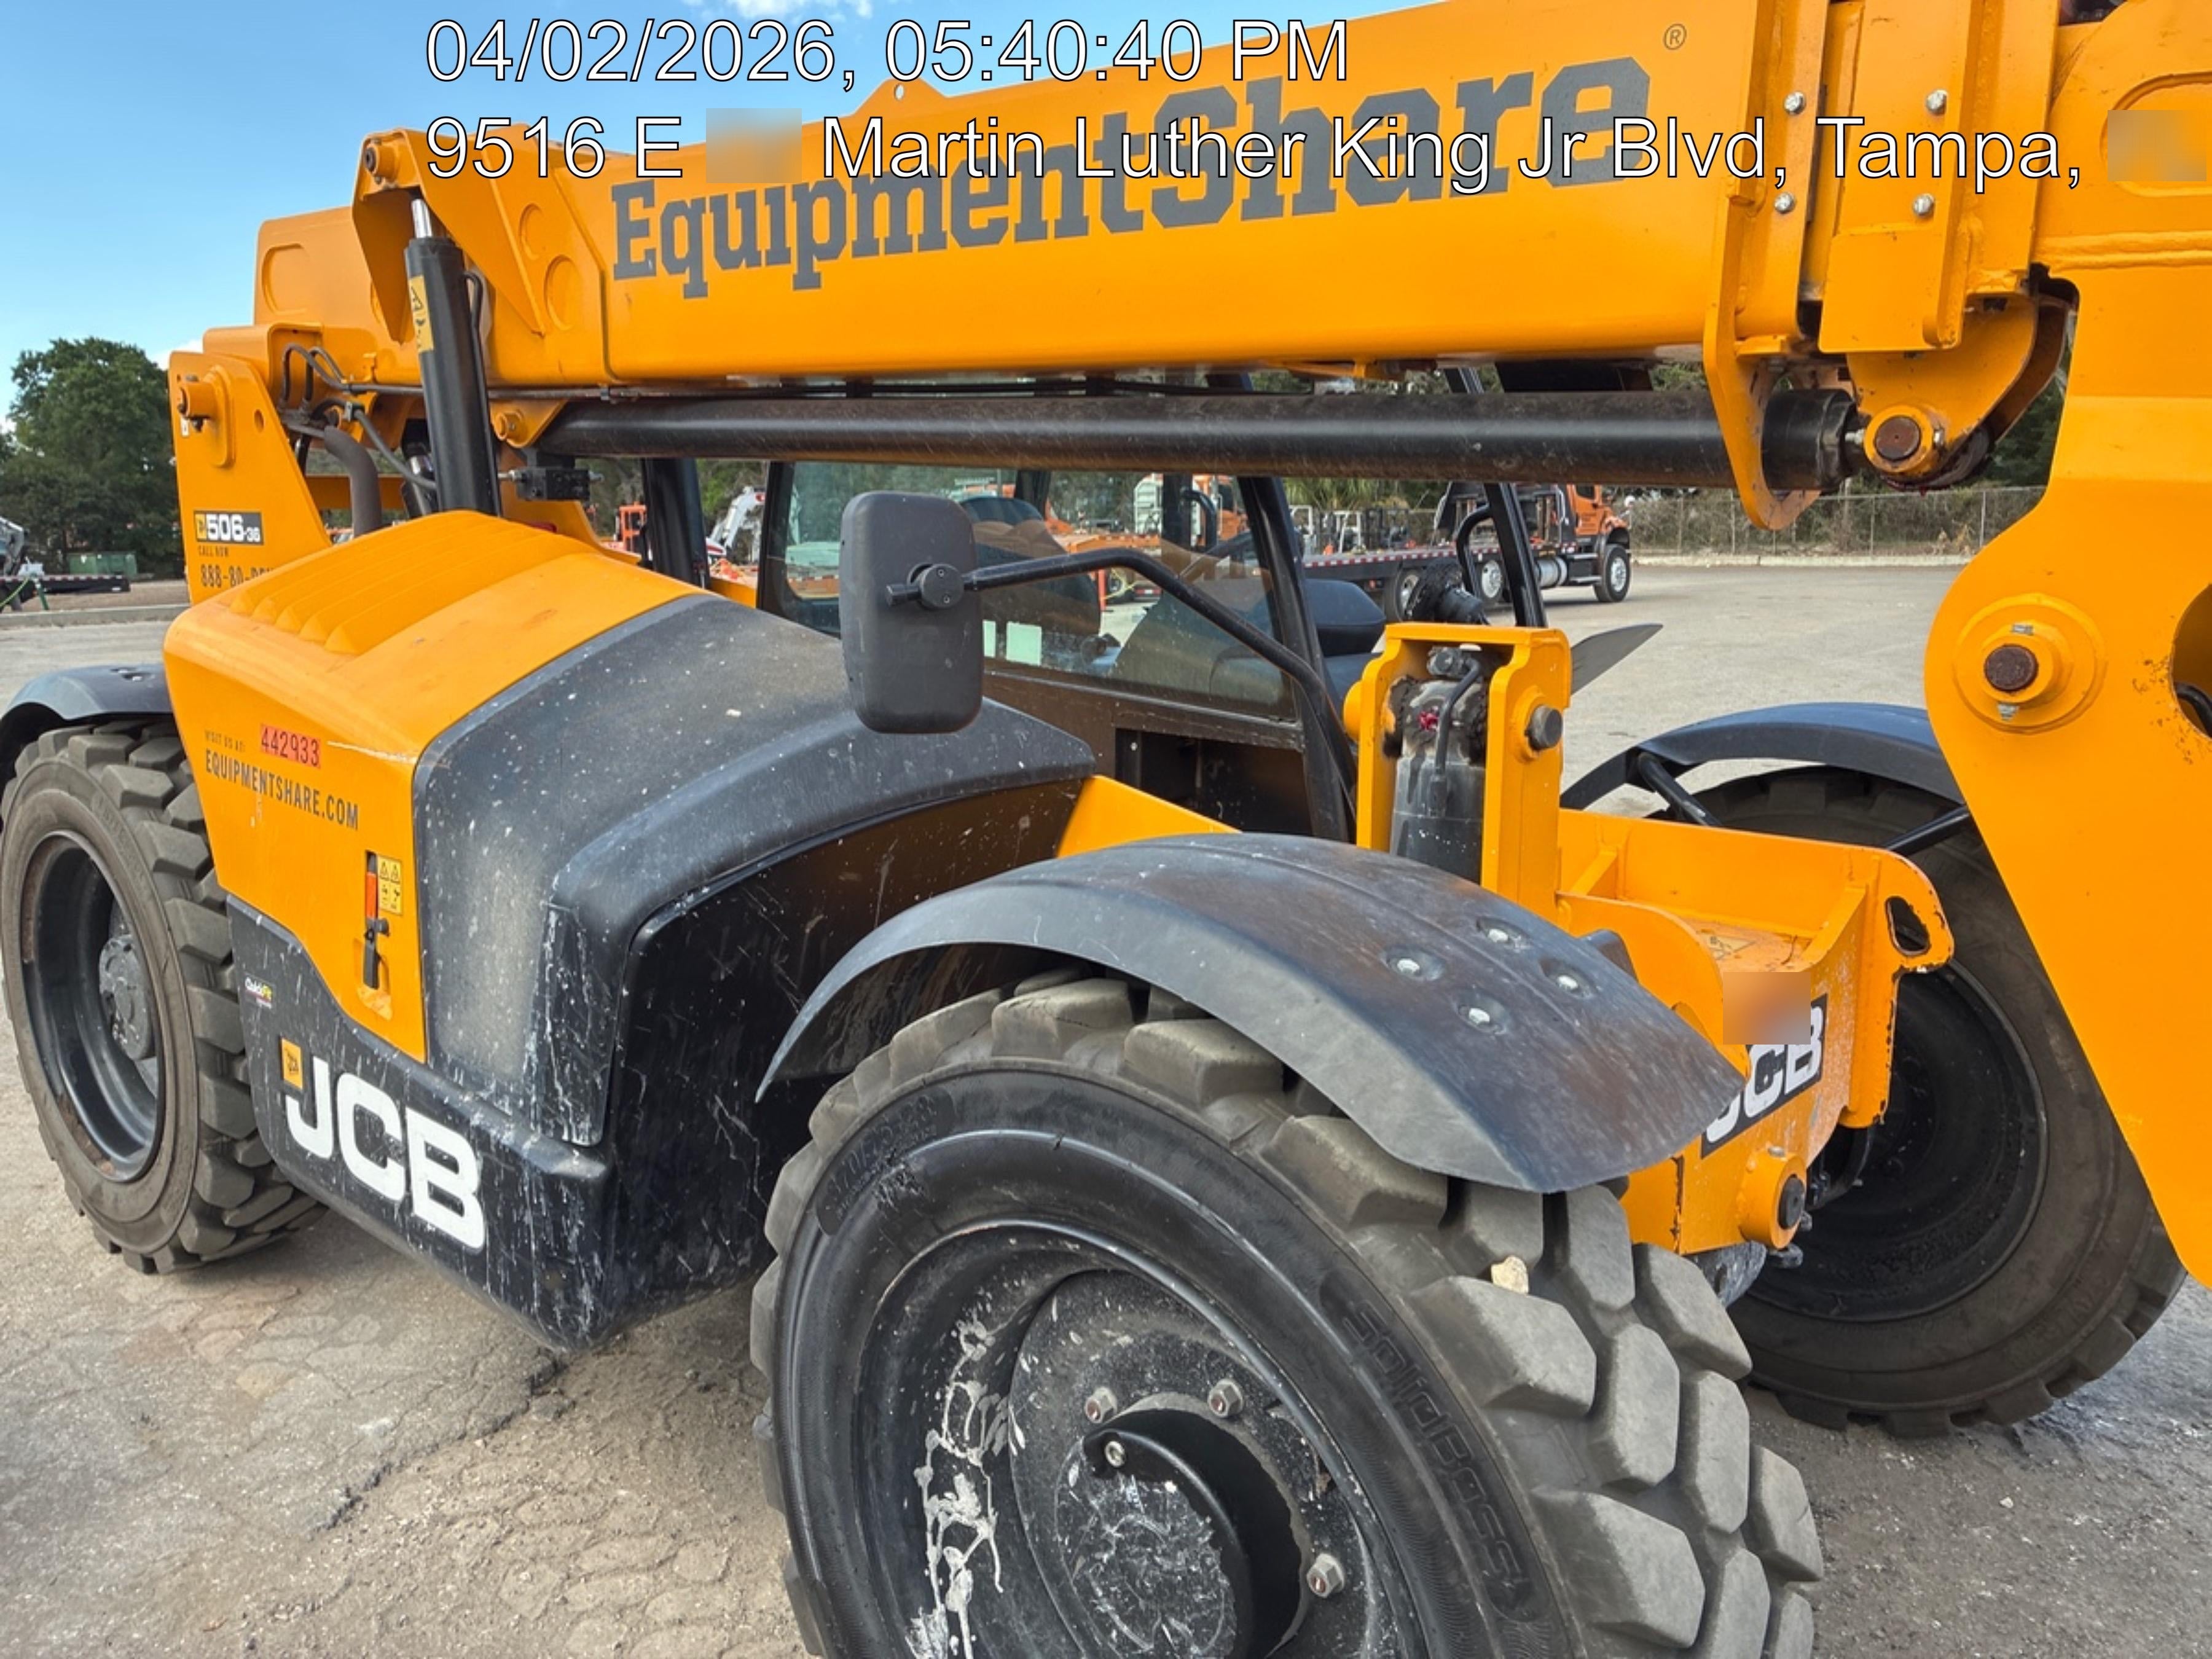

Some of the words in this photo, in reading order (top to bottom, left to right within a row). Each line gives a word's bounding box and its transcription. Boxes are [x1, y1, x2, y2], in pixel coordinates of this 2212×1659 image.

[611, 57, 1650, 299] EquipmentShare
[206, 749, 359, 831] EQUIPMENTSHARE.COM
[261, 726, 320, 767] 442933
[285, 1055, 485, 1249] JCB
